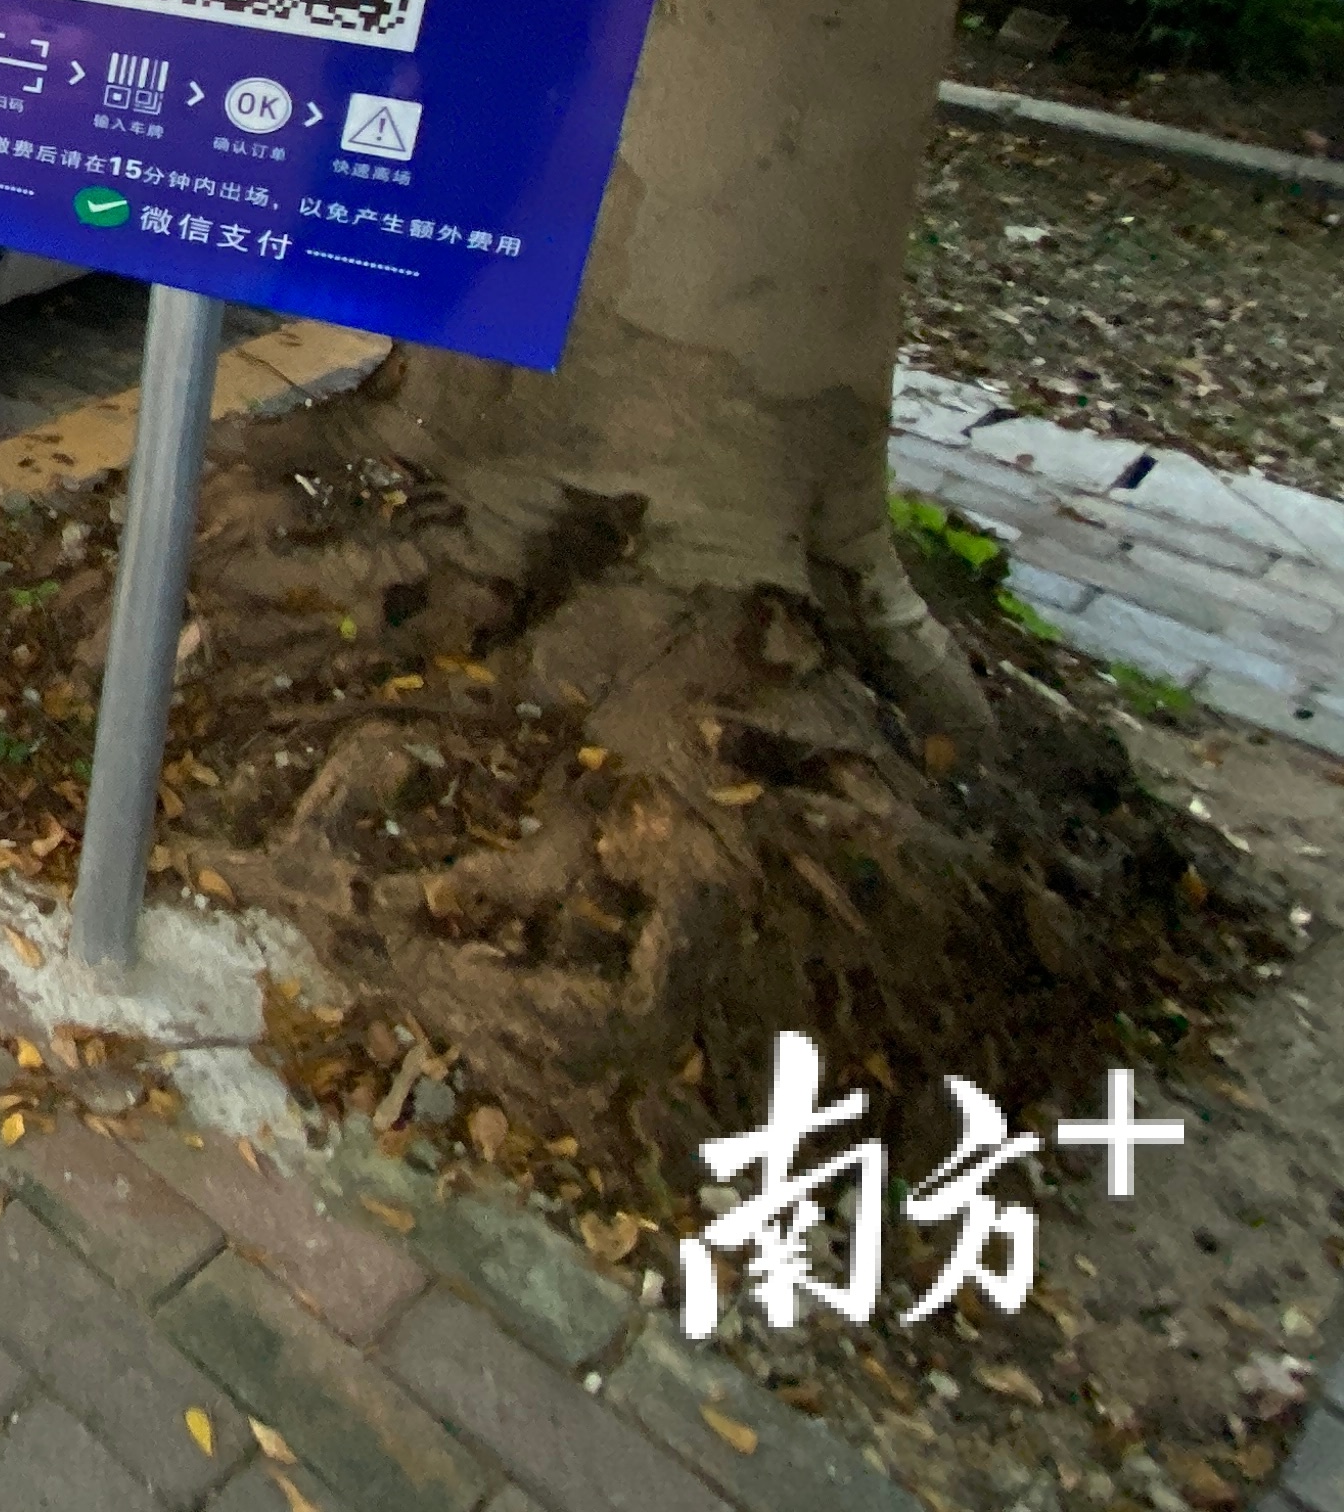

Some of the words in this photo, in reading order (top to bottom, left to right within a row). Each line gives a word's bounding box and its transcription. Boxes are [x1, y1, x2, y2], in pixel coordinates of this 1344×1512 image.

[236, 92, 280, 120] OK
[93, 113, 165, 139] 输入车牌
[212, 136, 287, 161] 确认订单
[139, 205, 293, 261] 微信支付
